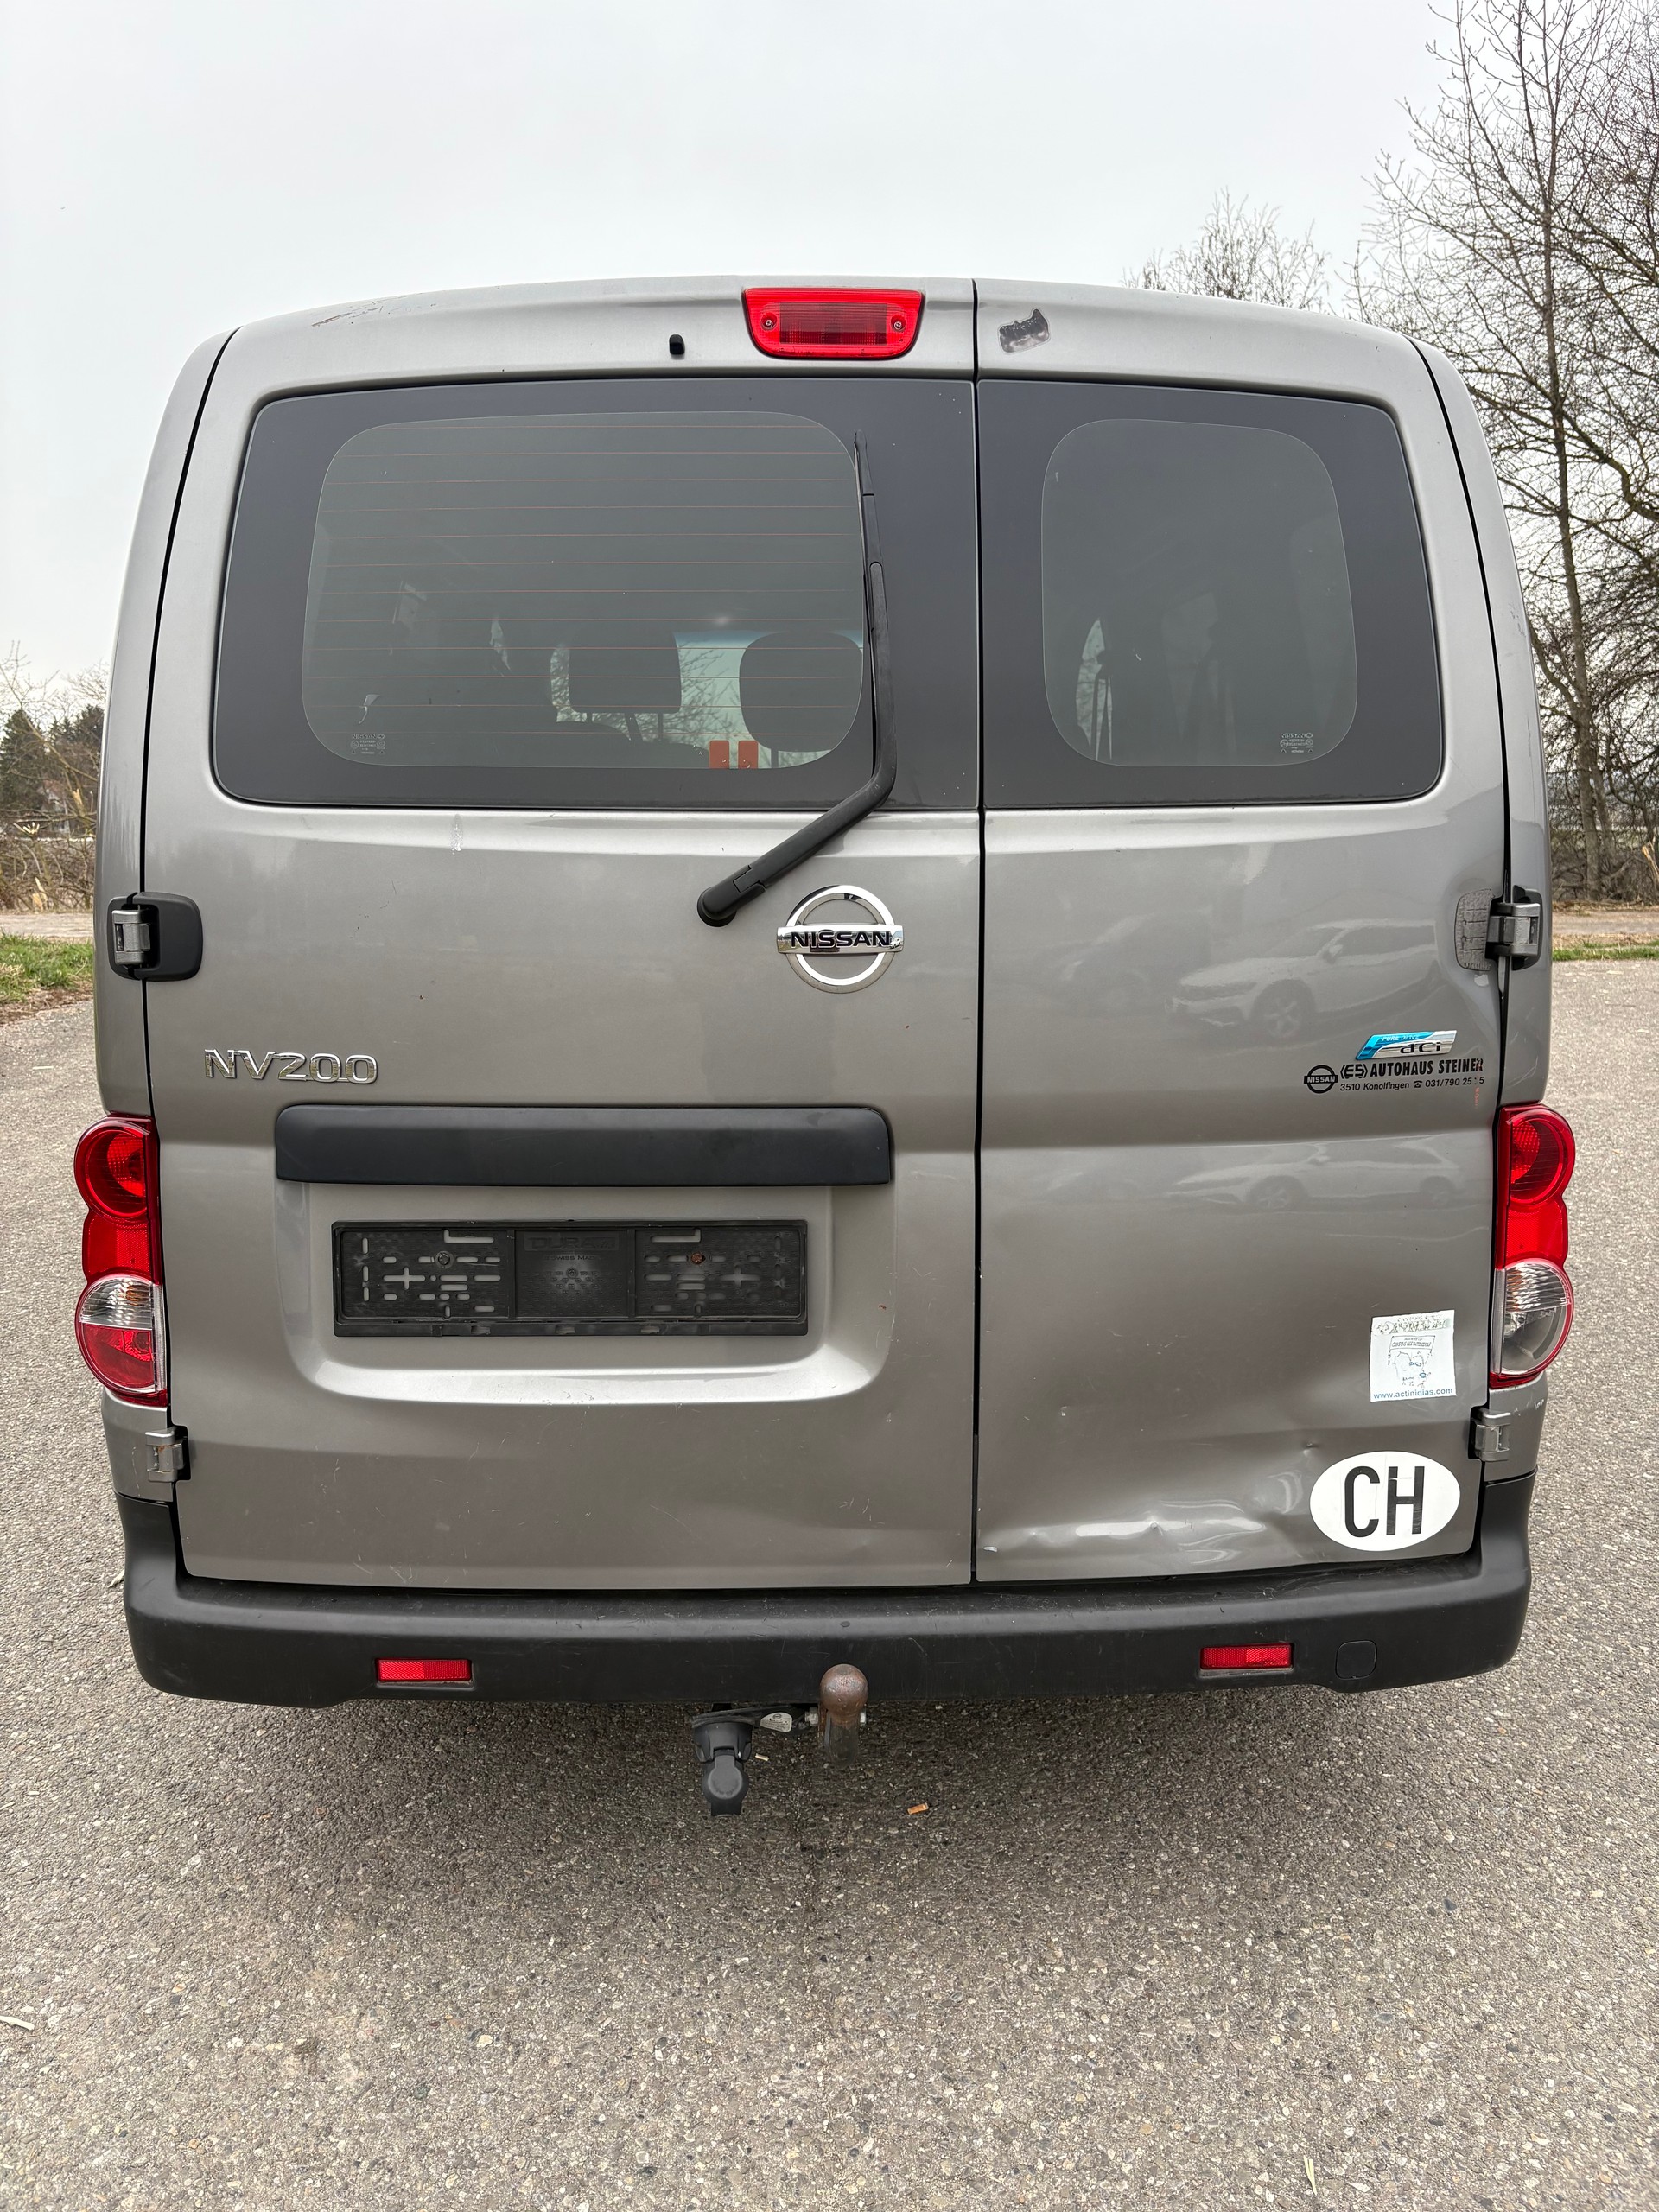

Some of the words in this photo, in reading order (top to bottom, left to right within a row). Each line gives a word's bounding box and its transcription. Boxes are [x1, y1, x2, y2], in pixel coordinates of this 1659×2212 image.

[790, 930, 891, 948] NISSAN
[204, 1048, 378, 1084] NV200
[1370, 1060, 1433, 1077] AUTOHAUS
[1438, 1058, 1484, 1074] STEINER
[1306, 1075, 1336, 1084] NISSAN
[1339, 1083, 1361, 1091] 3510
[1363, 1081, 1410, 1091] Konolfingen
[1425, 1077, 1460, 1088] 031/790
[1373, 1387, 1453, 1400] www.actinidias.com
[1344, 1465, 1426, 1538] CH
